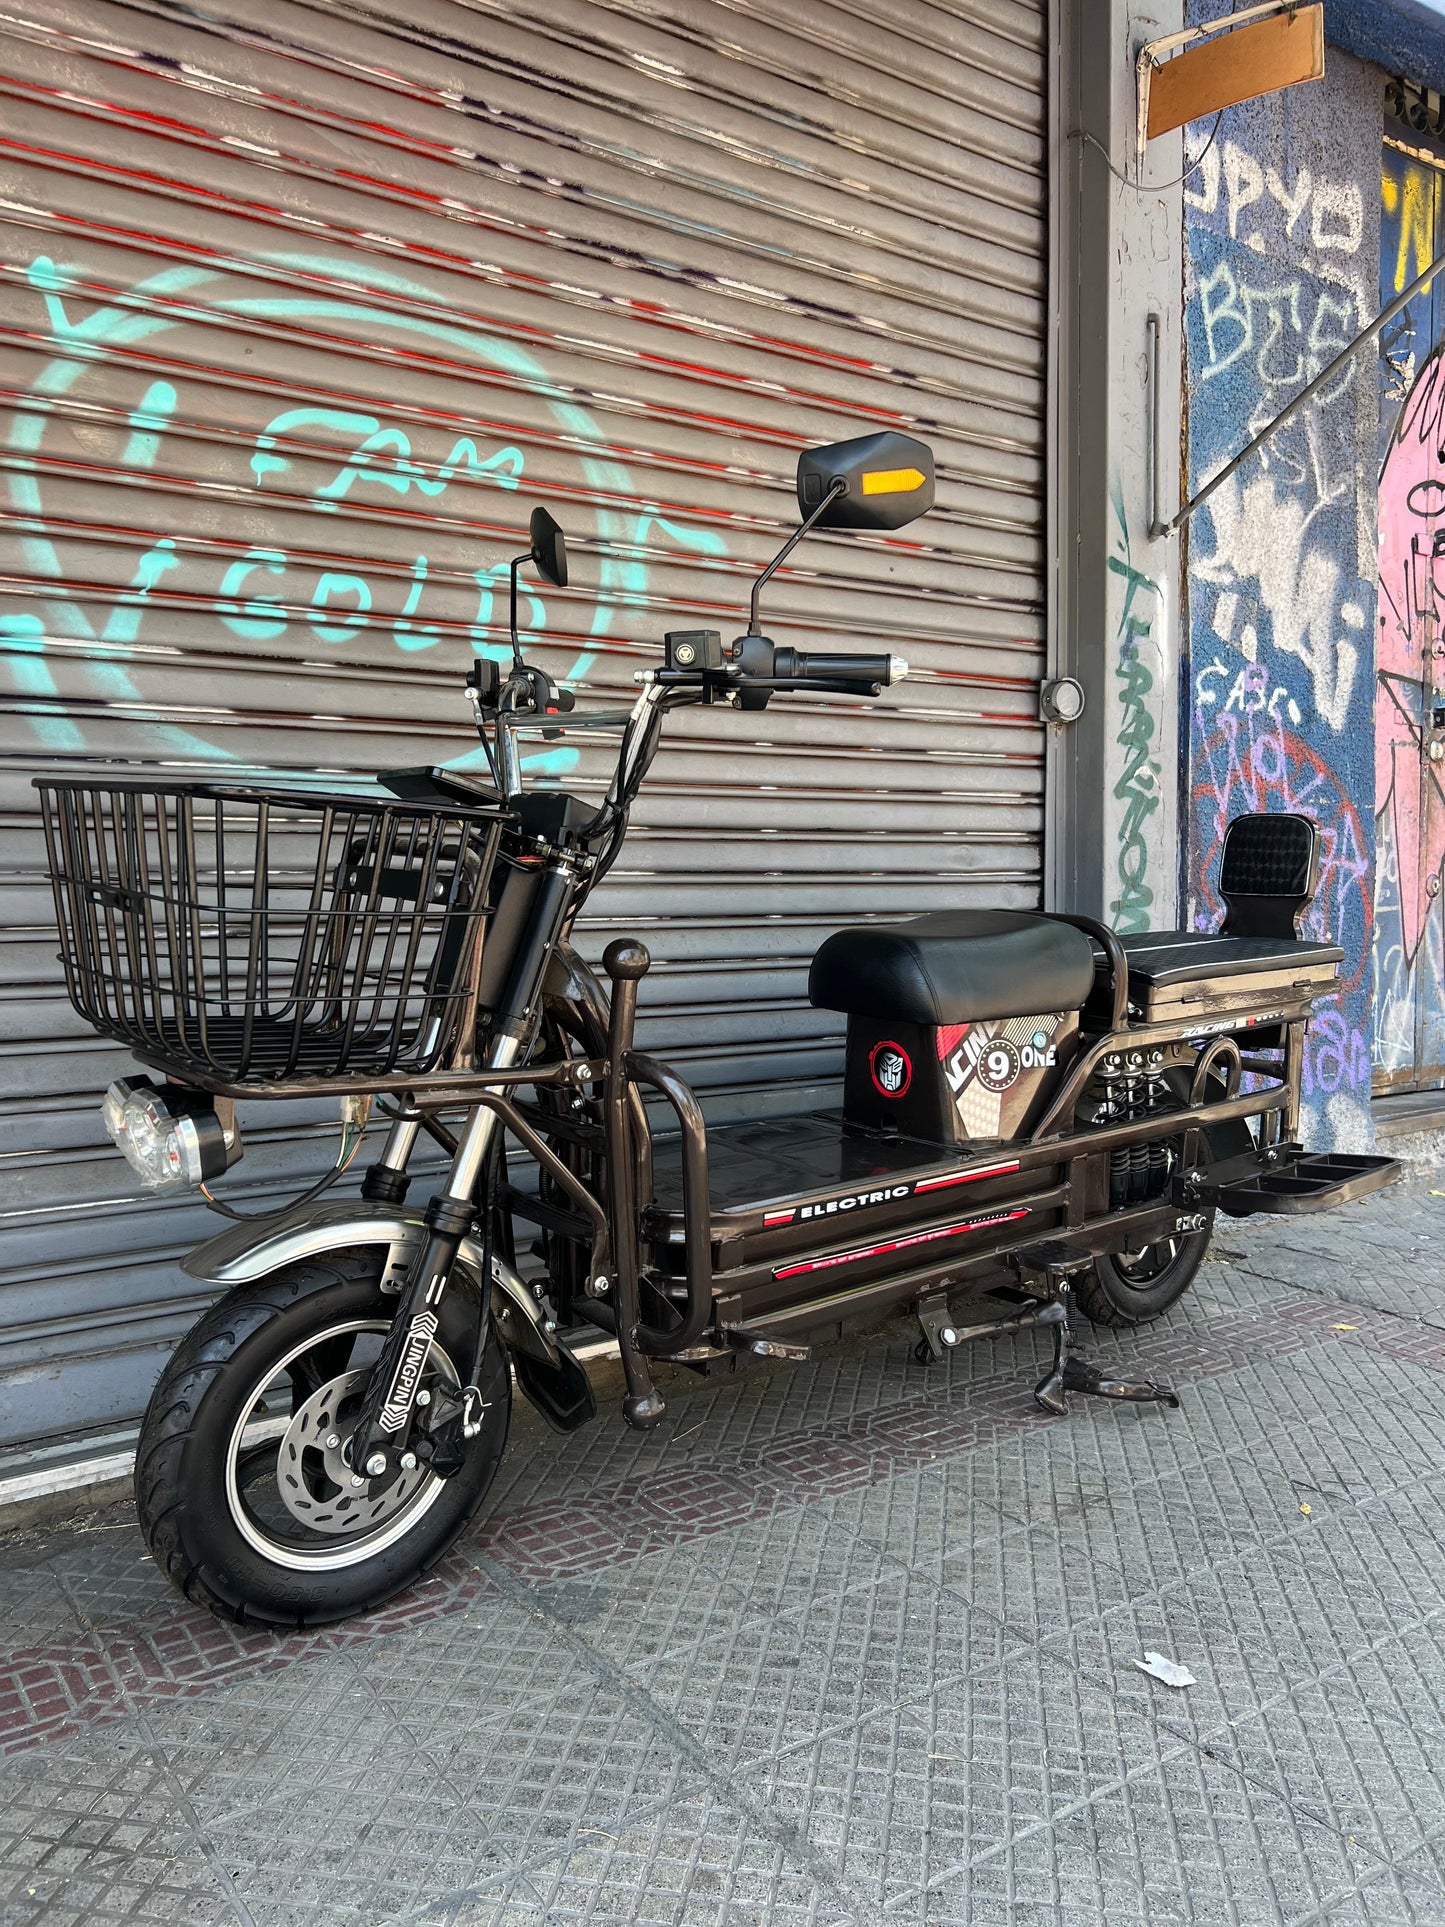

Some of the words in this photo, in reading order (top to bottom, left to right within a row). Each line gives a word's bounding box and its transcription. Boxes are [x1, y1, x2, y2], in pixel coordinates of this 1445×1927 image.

[1180, 1020, 1236, 1037] RACING
[987, 1050, 1010, 1080] 9
[1021, 1044, 1056, 1068] ONE
[801, 1186, 909, 1218] ELECTRIC
[394, 1337, 425, 1405] JINGPIN
